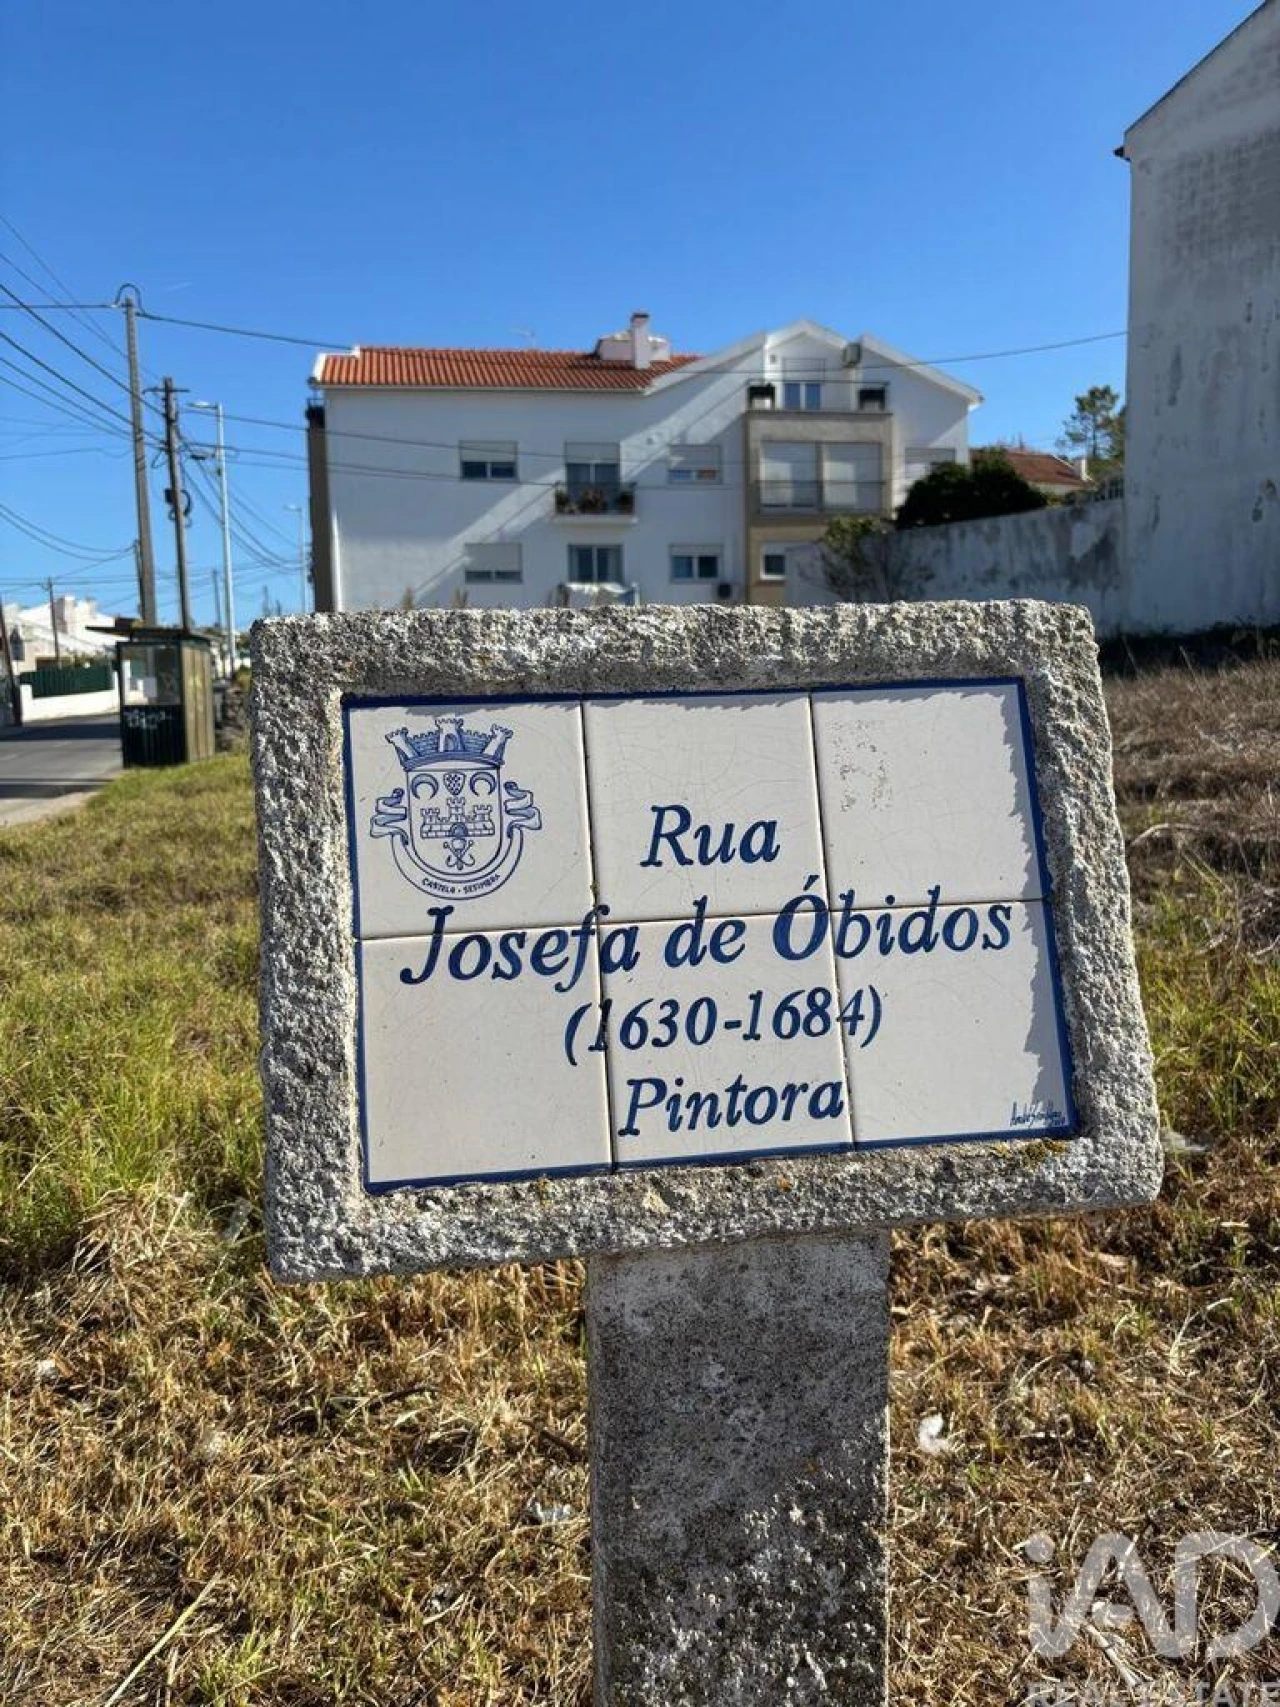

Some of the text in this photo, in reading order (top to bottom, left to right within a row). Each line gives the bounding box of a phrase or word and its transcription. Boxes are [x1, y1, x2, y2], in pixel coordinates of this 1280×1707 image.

[640, 803, 782, 868] Rua
[400, 874, 1012, 994] Josefa de Óbidos
[564, 983, 882, 1067] (1630-1684)
[618, 1076, 845, 1138] Pintora
